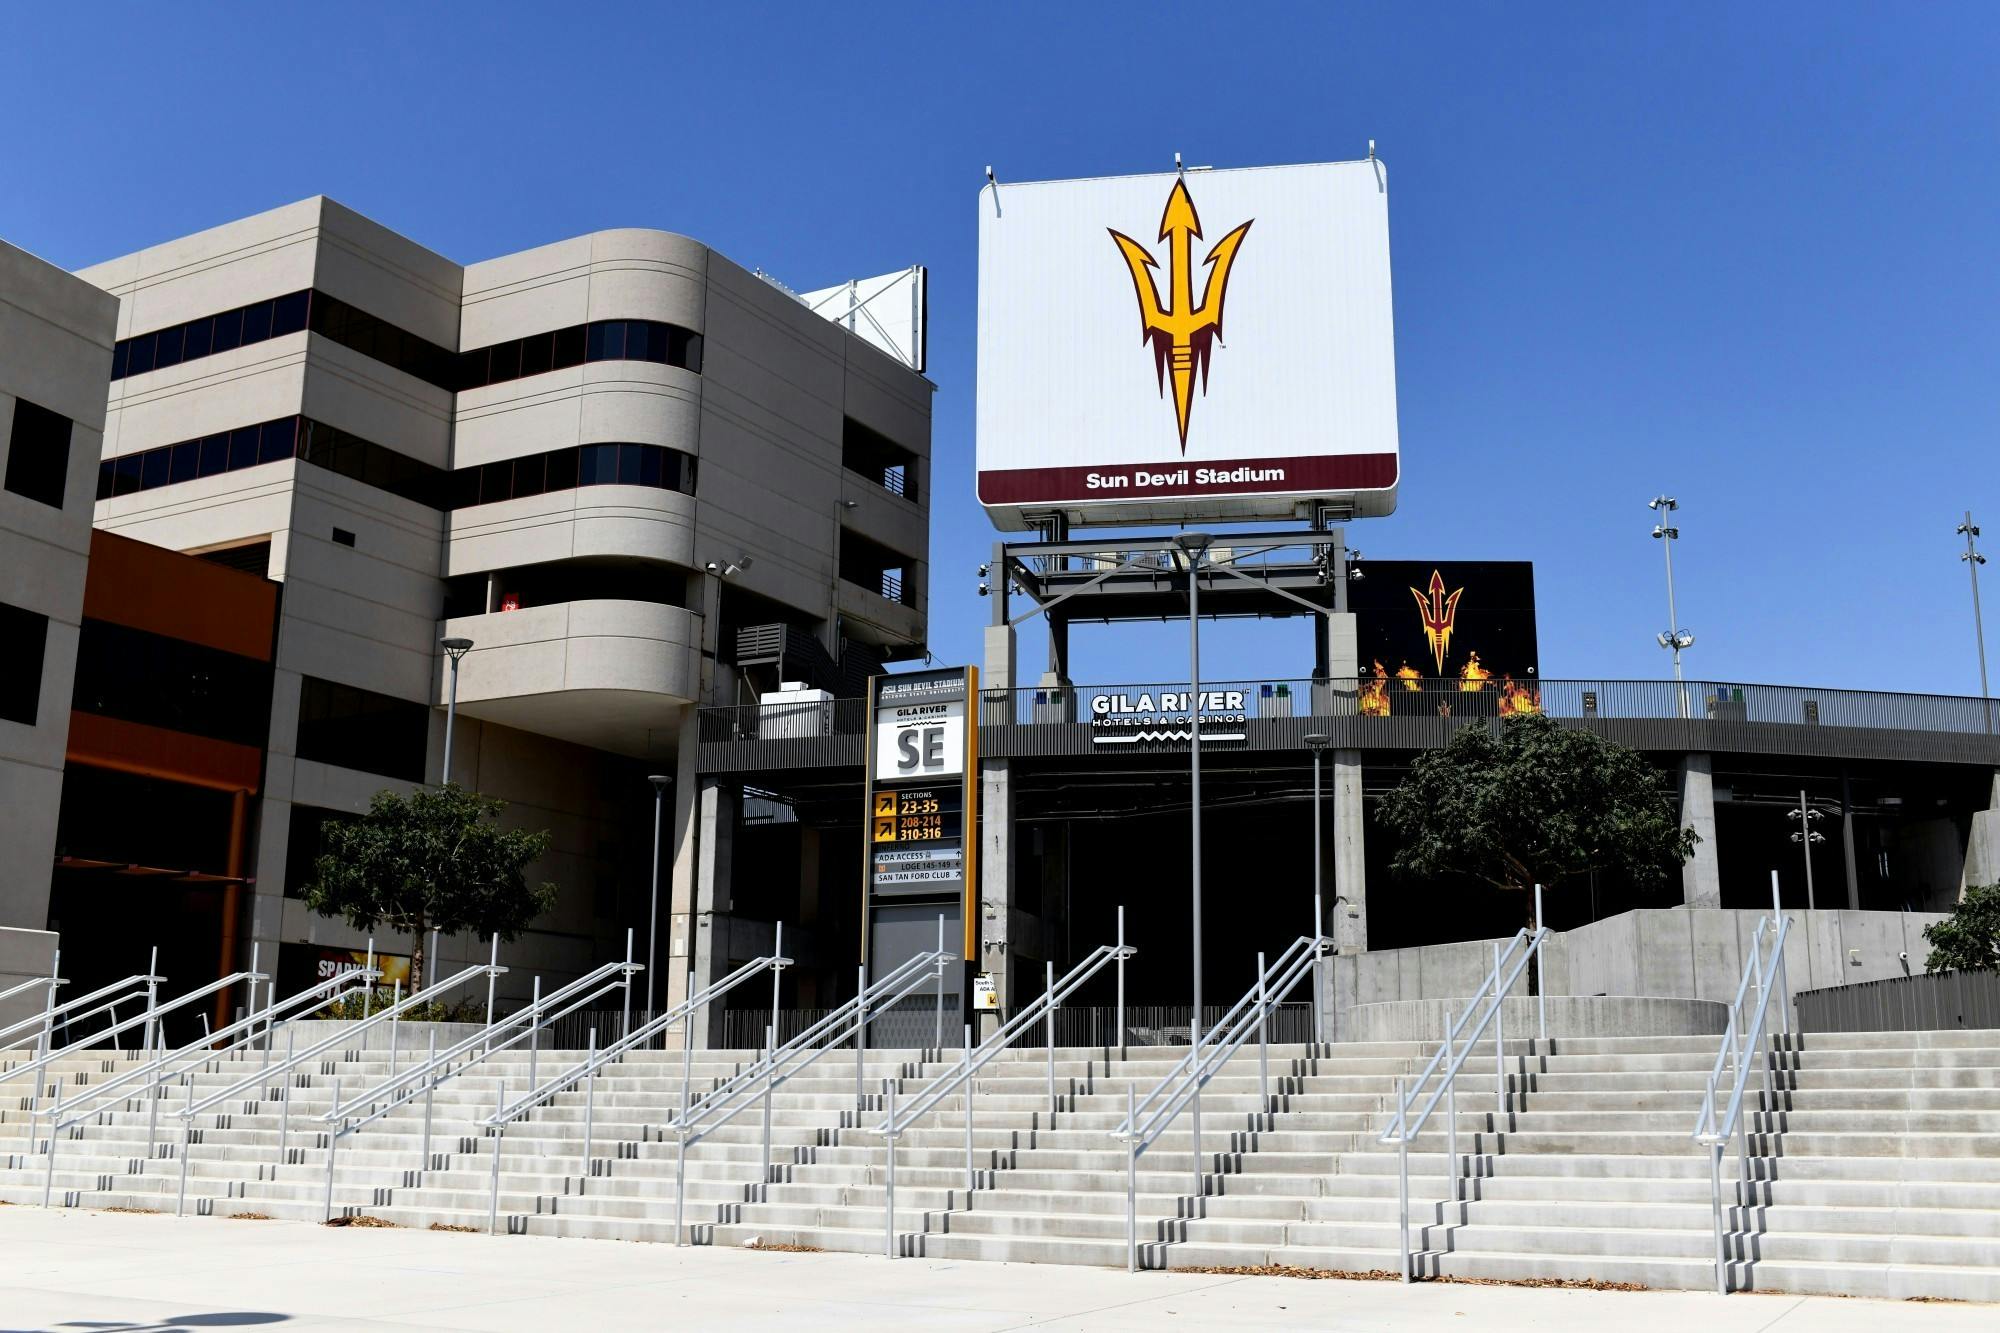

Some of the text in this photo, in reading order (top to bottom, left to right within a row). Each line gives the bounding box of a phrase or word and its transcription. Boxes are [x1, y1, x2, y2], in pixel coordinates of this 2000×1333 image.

[1086, 467, 1285, 489] Sun Devil Stadium
[897, 683, 912, 692] SUN
[913, 681, 932, 691] DEVIL
[933, 678, 964, 689] STADIUM
[929, 687, 965, 695] UNIVERSITY
[1092, 693, 1156, 714] GILA
[1161, 691, 1244, 712] RIVER
[897, 705, 947, 717] GILA RIVER
[1092, 714, 1245, 727] HOTELS & CASINOS
[897, 727, 945, 770] SE
[901, 791, 932, 800] SECTIONS
[901, 799, 939, 815] 23-35
[901, 815, 942, 828] 208-214
[900, 827, 942, 841] 310-316
[878, 852, 924, 862] ADA ACCESS
[901, 861, 951, 871] LOGE 145-149
[878, 871, 950, 882] SAN TAN FORD CLUB
